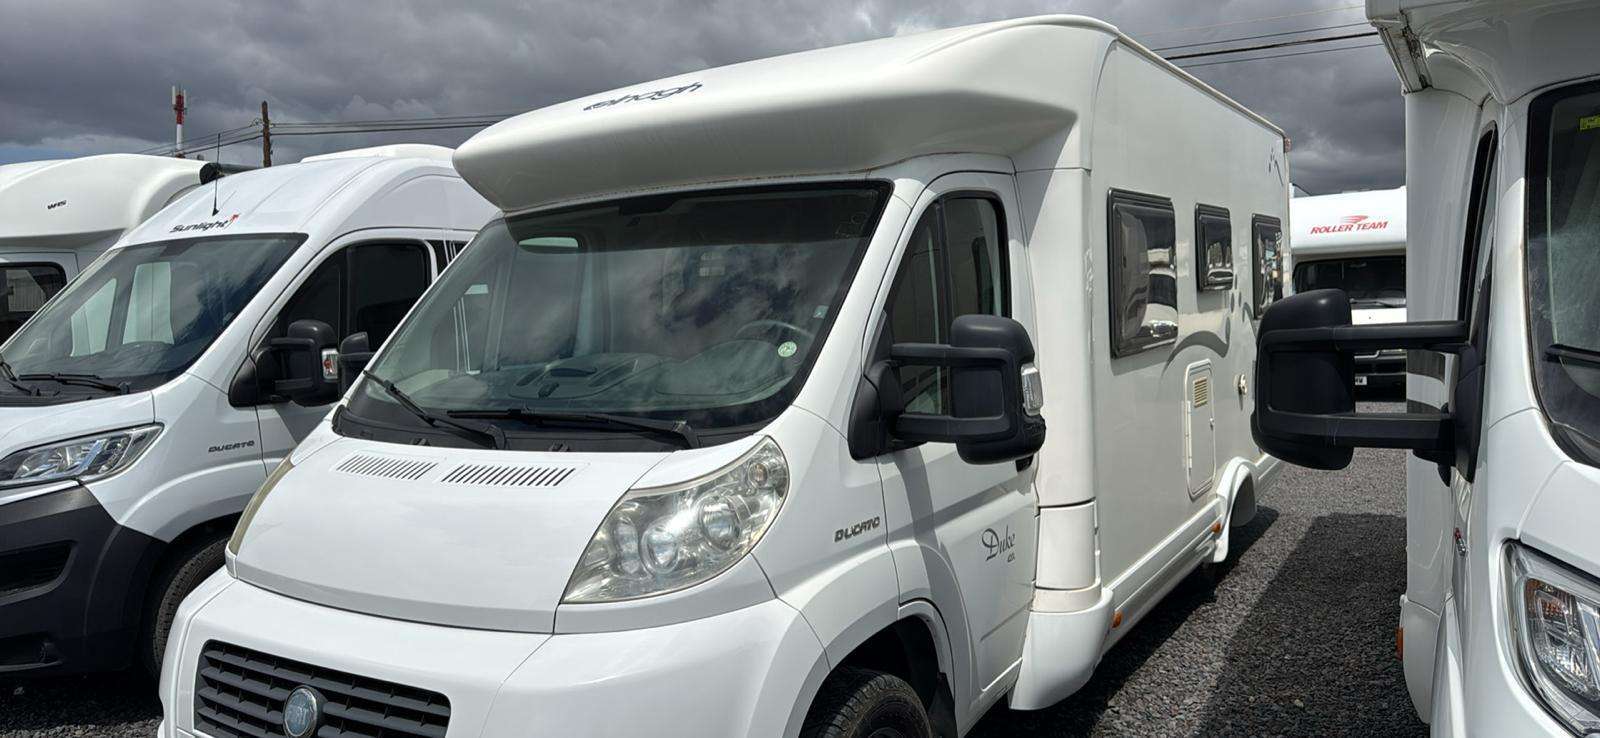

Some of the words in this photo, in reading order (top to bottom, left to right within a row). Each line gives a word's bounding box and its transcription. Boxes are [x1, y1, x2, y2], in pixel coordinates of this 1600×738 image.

[170, 220, 229, 233] Sunlight
[1310, 224, 1354, 235] ROLLER
[1356, 221, 1388, 231] TEAM
[208, 440, 255, 453] DUCATO
[834, 516, 881, 543] DUCATO
[981, 524, 1016, 562] Duke
